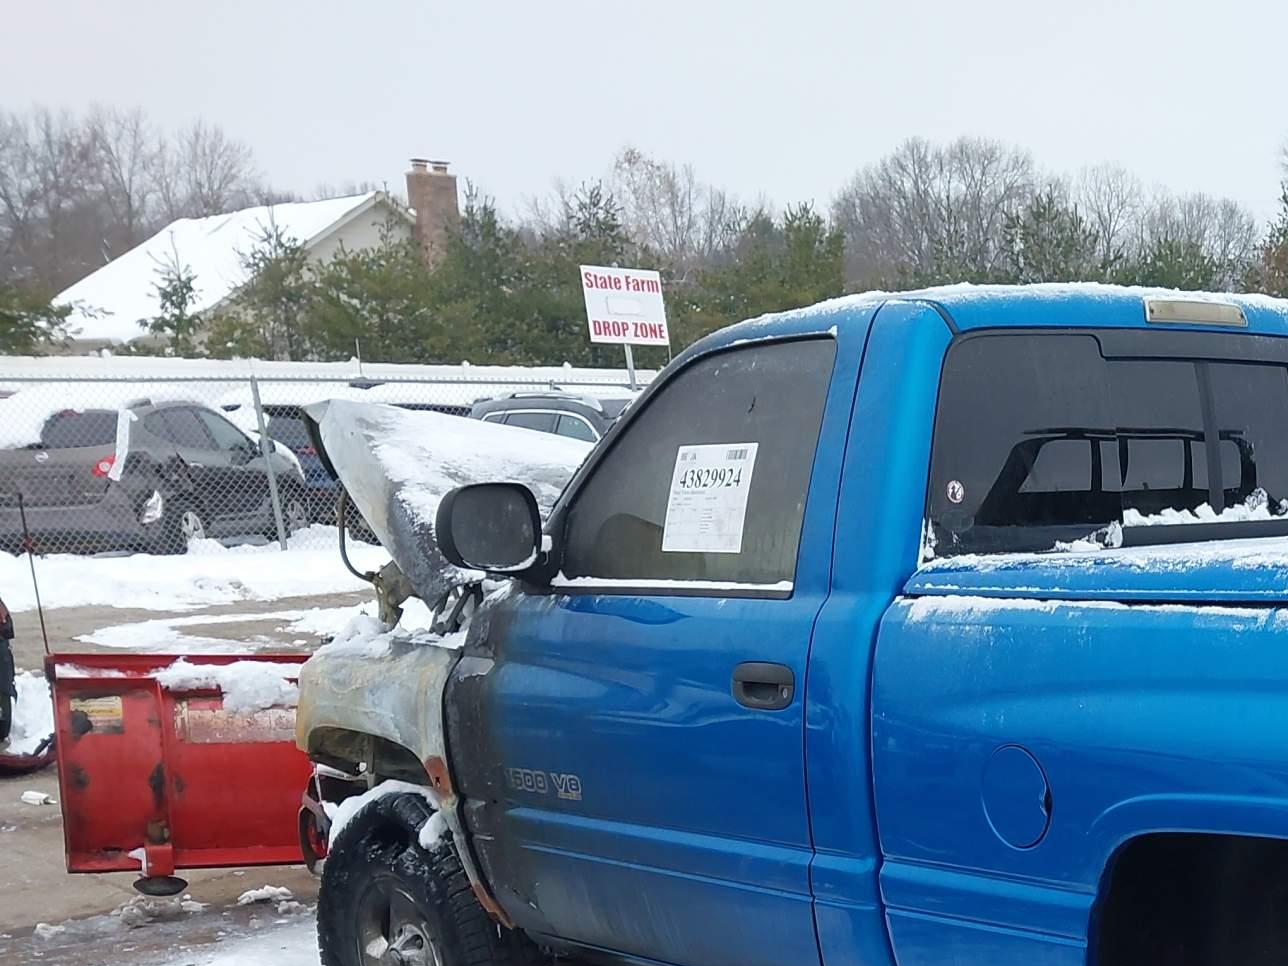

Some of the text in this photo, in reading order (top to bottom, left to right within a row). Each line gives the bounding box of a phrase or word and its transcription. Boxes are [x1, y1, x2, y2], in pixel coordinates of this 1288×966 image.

[584, 272, 659, 293] State Farm
[593, 320, 666, 340] DROP ZONE
[679, 467, 743, 488] 43829924
[550, 772, 582, 793] V8
